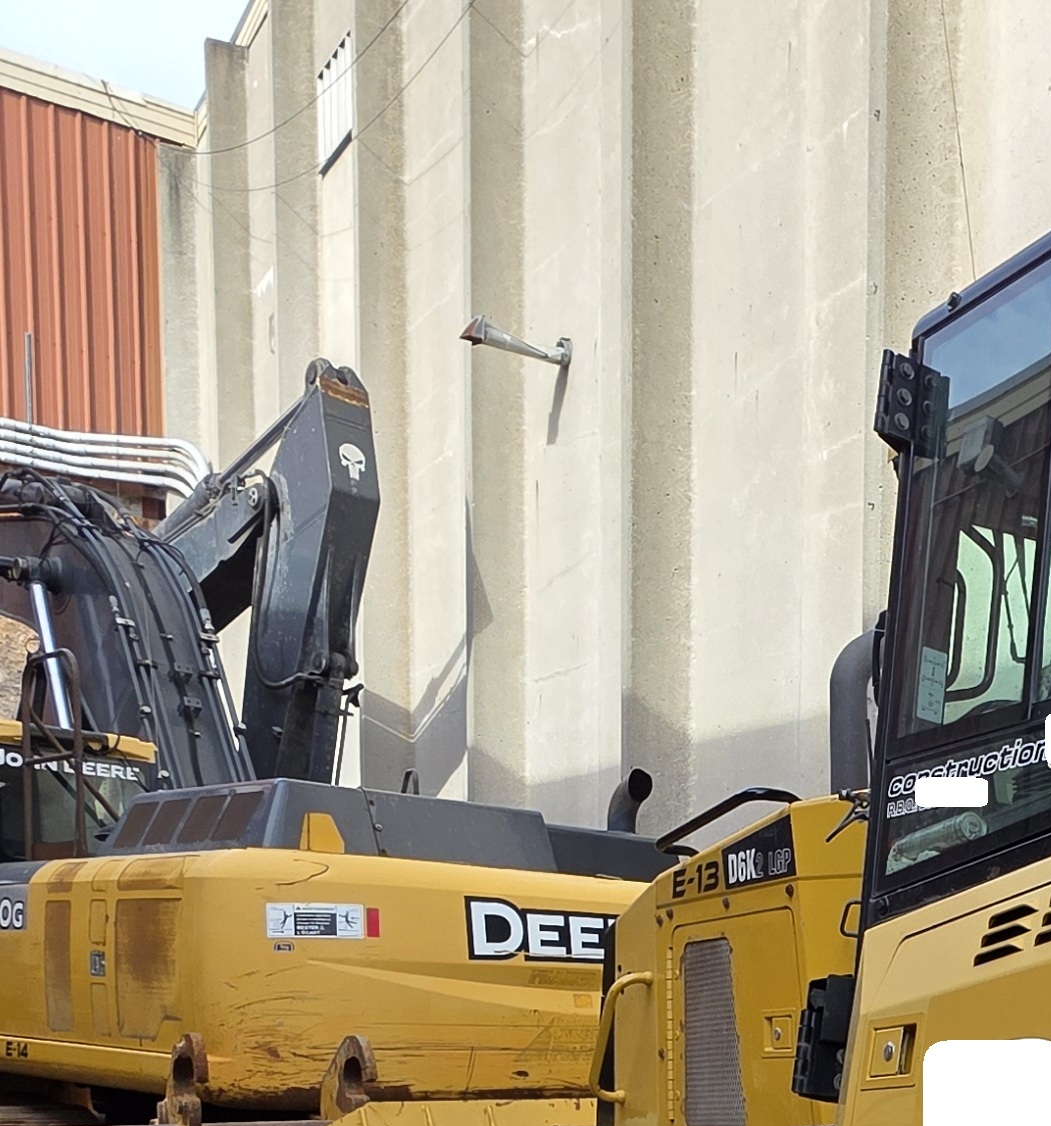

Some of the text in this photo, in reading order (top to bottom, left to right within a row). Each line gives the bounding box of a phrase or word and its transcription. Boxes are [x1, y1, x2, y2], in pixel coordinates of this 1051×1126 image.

[0, 748, 58, 772] JON
[768, 848, 792, 876] LGP
[672, 861, 720, 899] E-13
[469, 900, 616, 960] DEE
[5, 1041, 28, 1058] E-14
